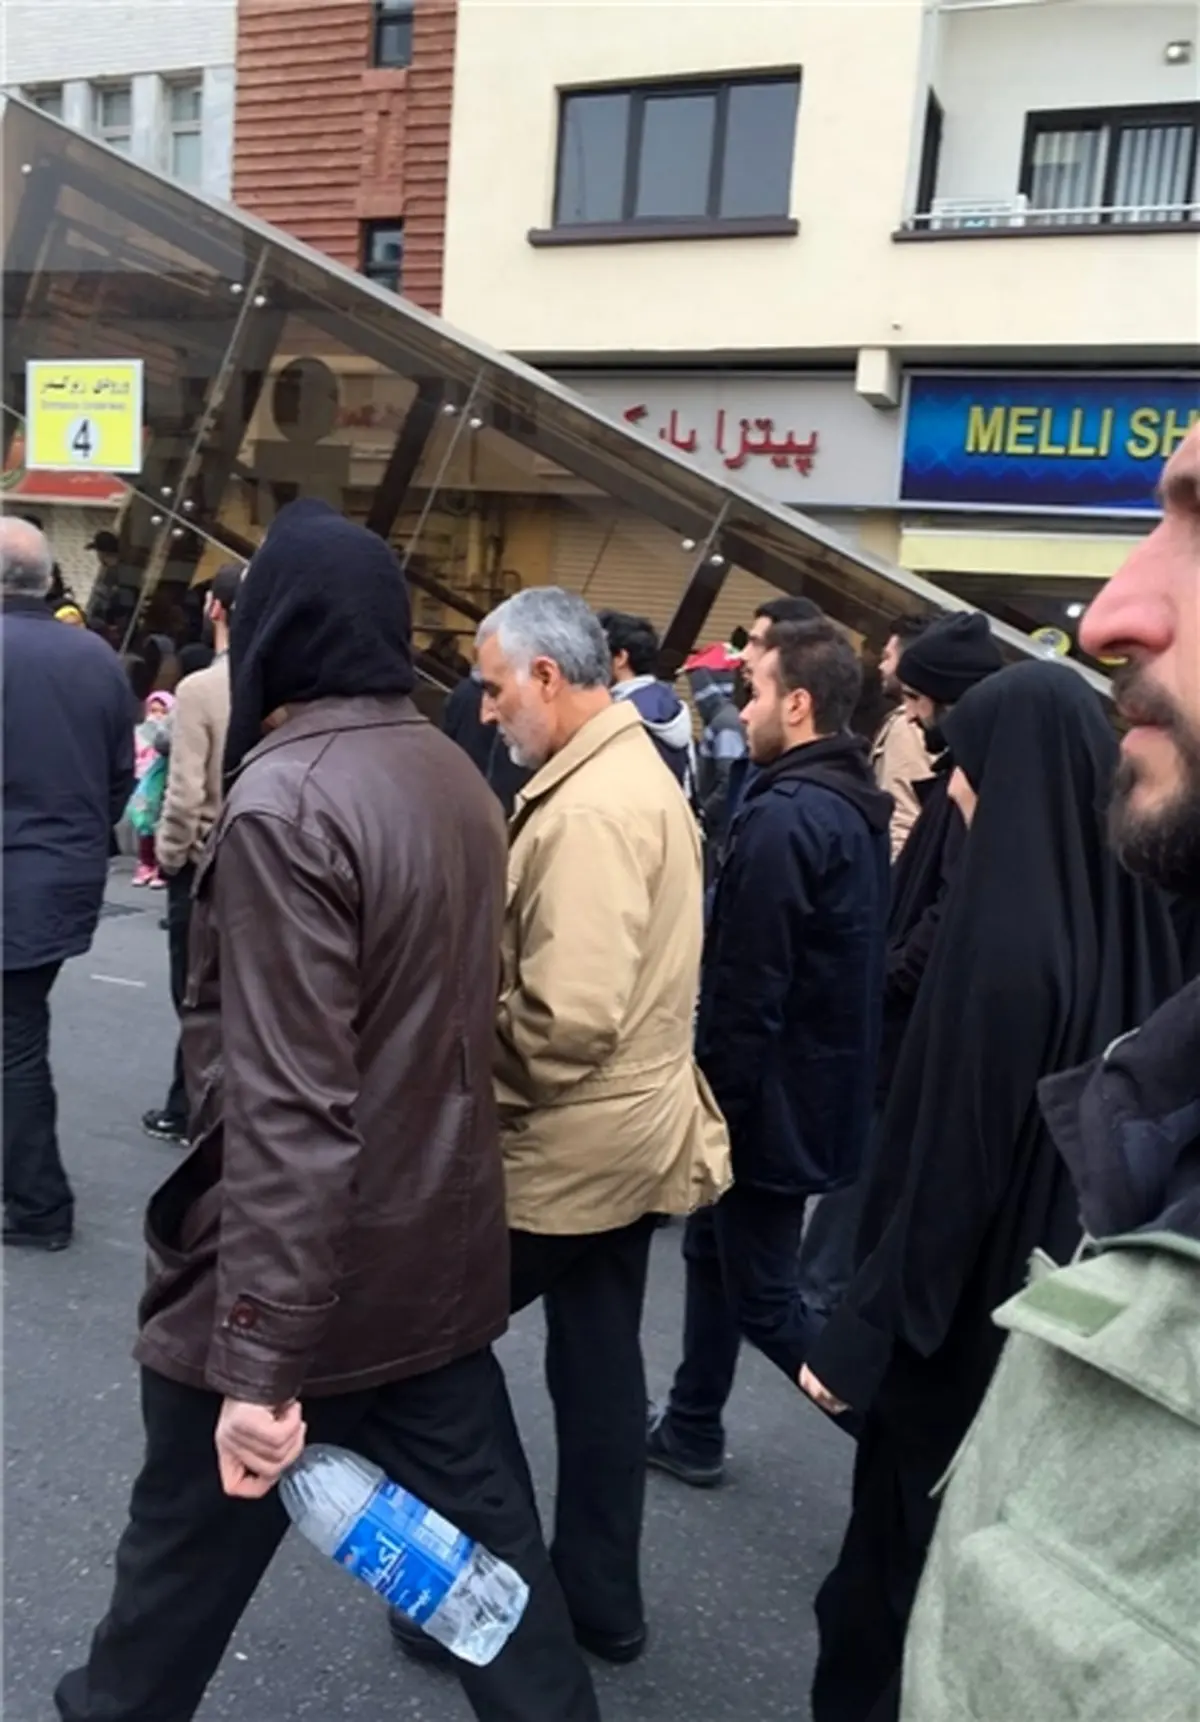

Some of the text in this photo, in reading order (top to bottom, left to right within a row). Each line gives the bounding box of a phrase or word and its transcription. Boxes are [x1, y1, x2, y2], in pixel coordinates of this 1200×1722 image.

[72, 419, 91, 458] 4
[717, 409, 818, 477] پیتزا
[965, 405, 1113, 457] MELLI
